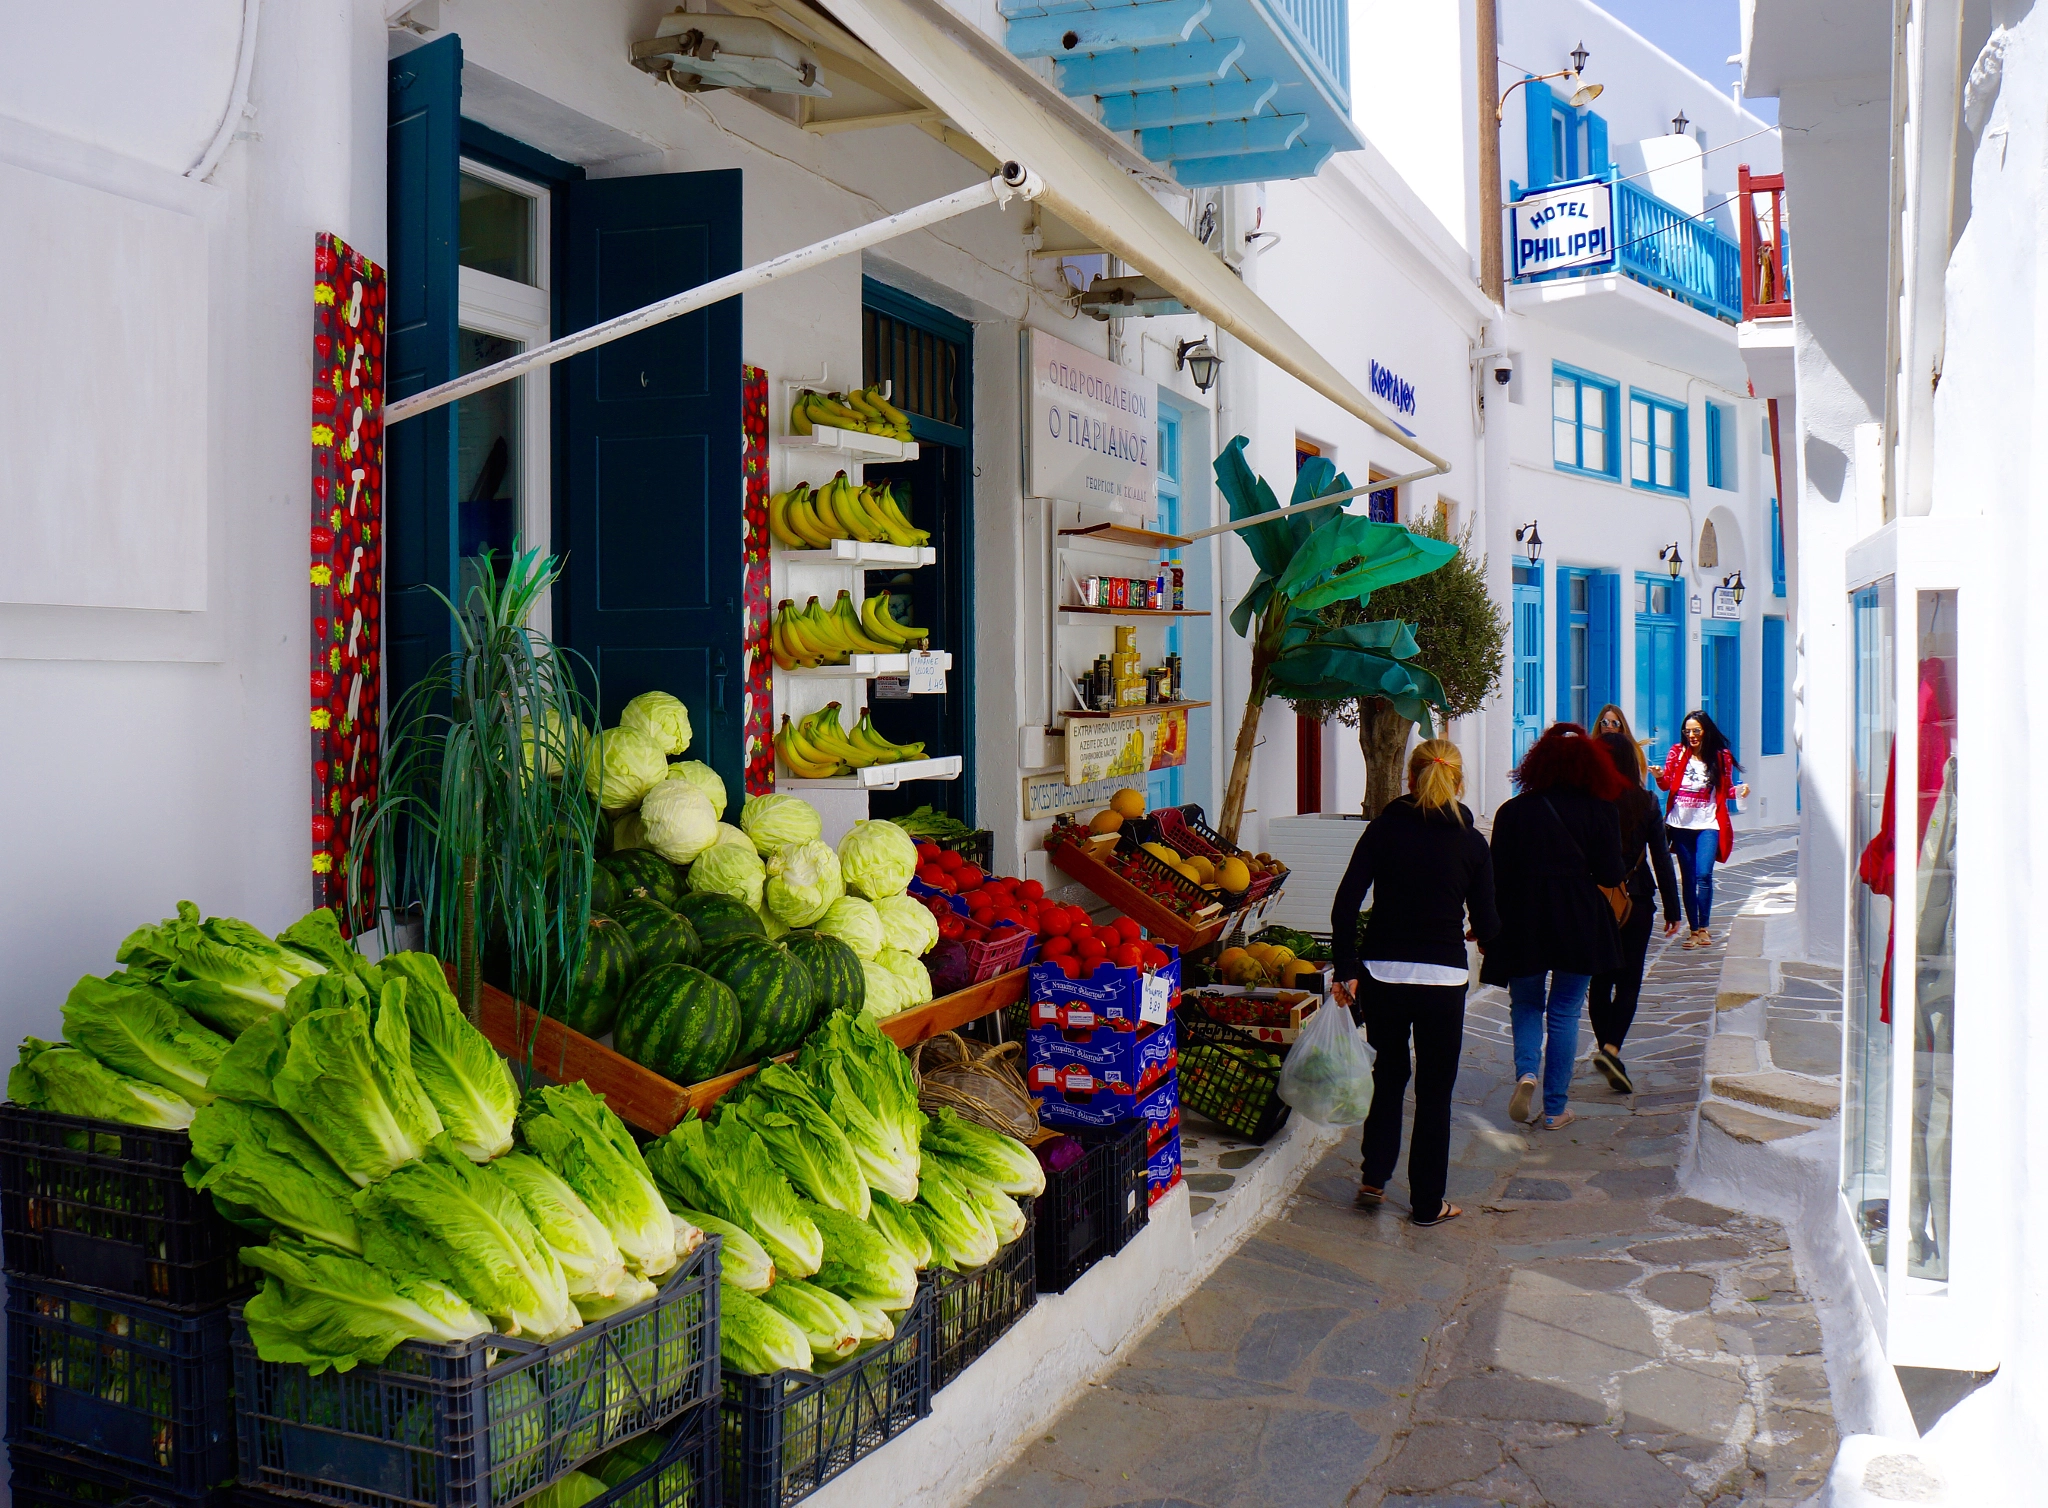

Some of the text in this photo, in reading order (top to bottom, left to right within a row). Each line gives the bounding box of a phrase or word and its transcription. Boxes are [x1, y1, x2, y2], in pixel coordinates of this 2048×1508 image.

[1530, 202, 1588, 230] HOTEL
[1520, 227, 1606, 269] PHILIPPI
[1049, 360, 1147, 419] ΟΠΩΡΟΠΩΛΕΙΟΝ
[1049, 405, 1148, 467] Ο ΠΑΡΙΑΝΟΣ
[1073, 724, 1092, 737] EXTRA
[1093, 722, 1110, 735] VIRGIN
